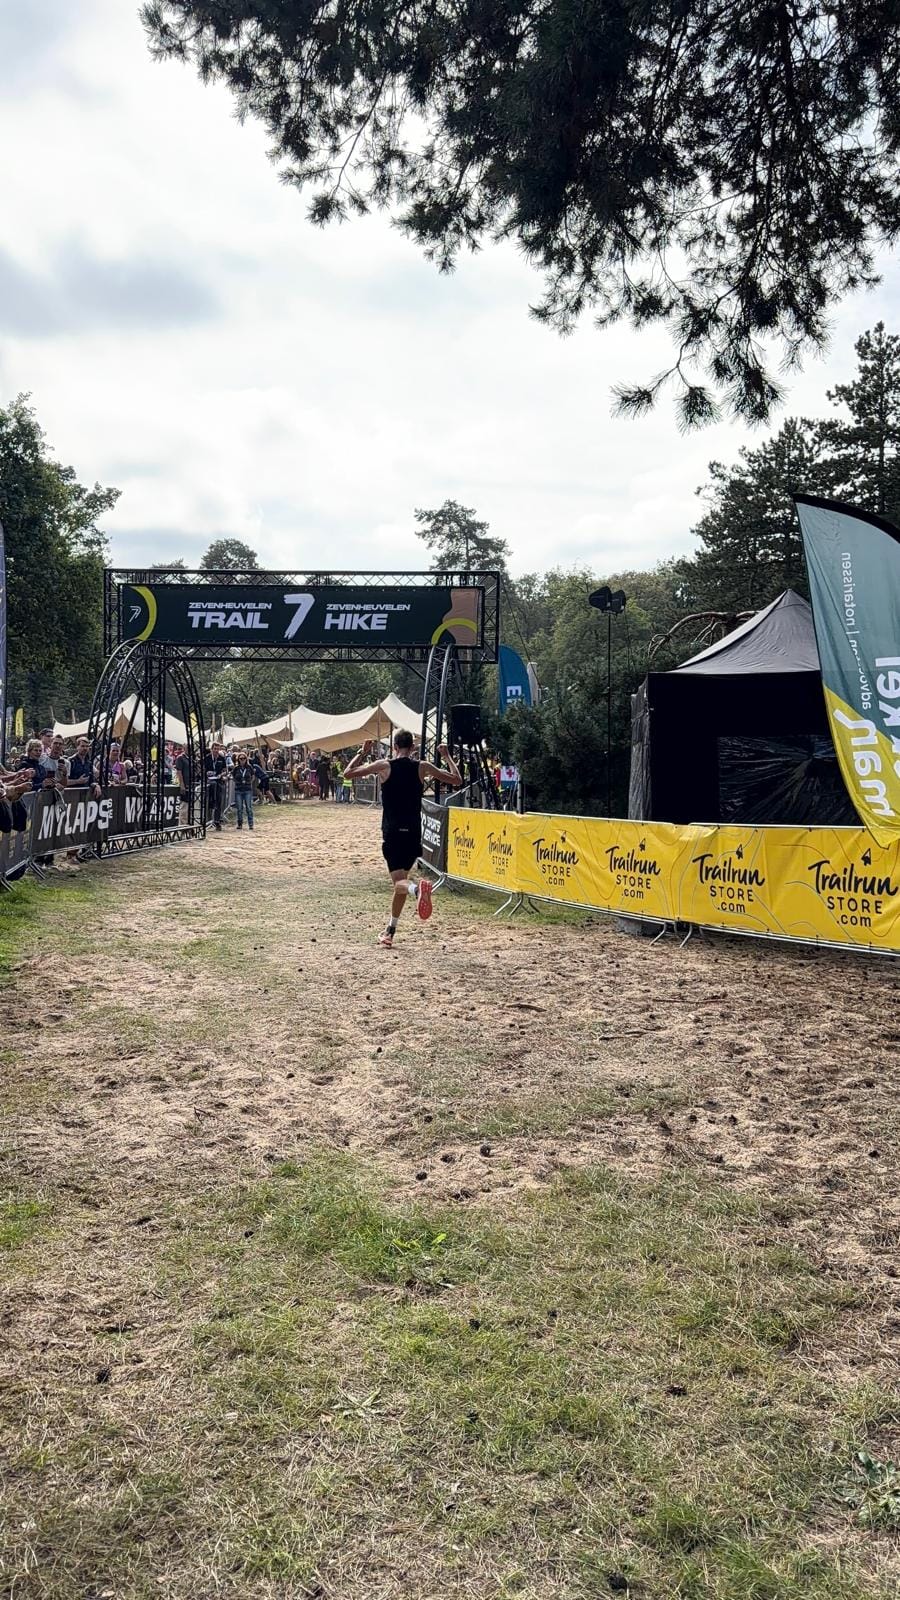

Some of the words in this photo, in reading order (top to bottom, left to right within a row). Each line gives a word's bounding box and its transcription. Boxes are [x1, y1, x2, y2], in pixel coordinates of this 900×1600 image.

[326, 603, 411, 611] ZEVENHEUVELEN
[187, 611, 270, 629] TRAIL
[283, 593, 316, 640] 7
[324, 613, 389, 630] HIKE
[38, 801, 109, 840] MYLAPS
[532, 838, 580, 865] Trailrun
[605, 845, 661, 876] Trailrun
[541, 864, 571, 877] STORE
[692, 853, 765, 886] Trailrun
[808, 859, 899, 896] Trailrun
[615, 874, 651, 889] STORE
[621, 888, 644, 899] .com
[709, 885, 754, 902] STORE
[717, 900, 746, 913] .com
[827, 896, 883, 914] STORE
[837, 914, 872, 927] .com
